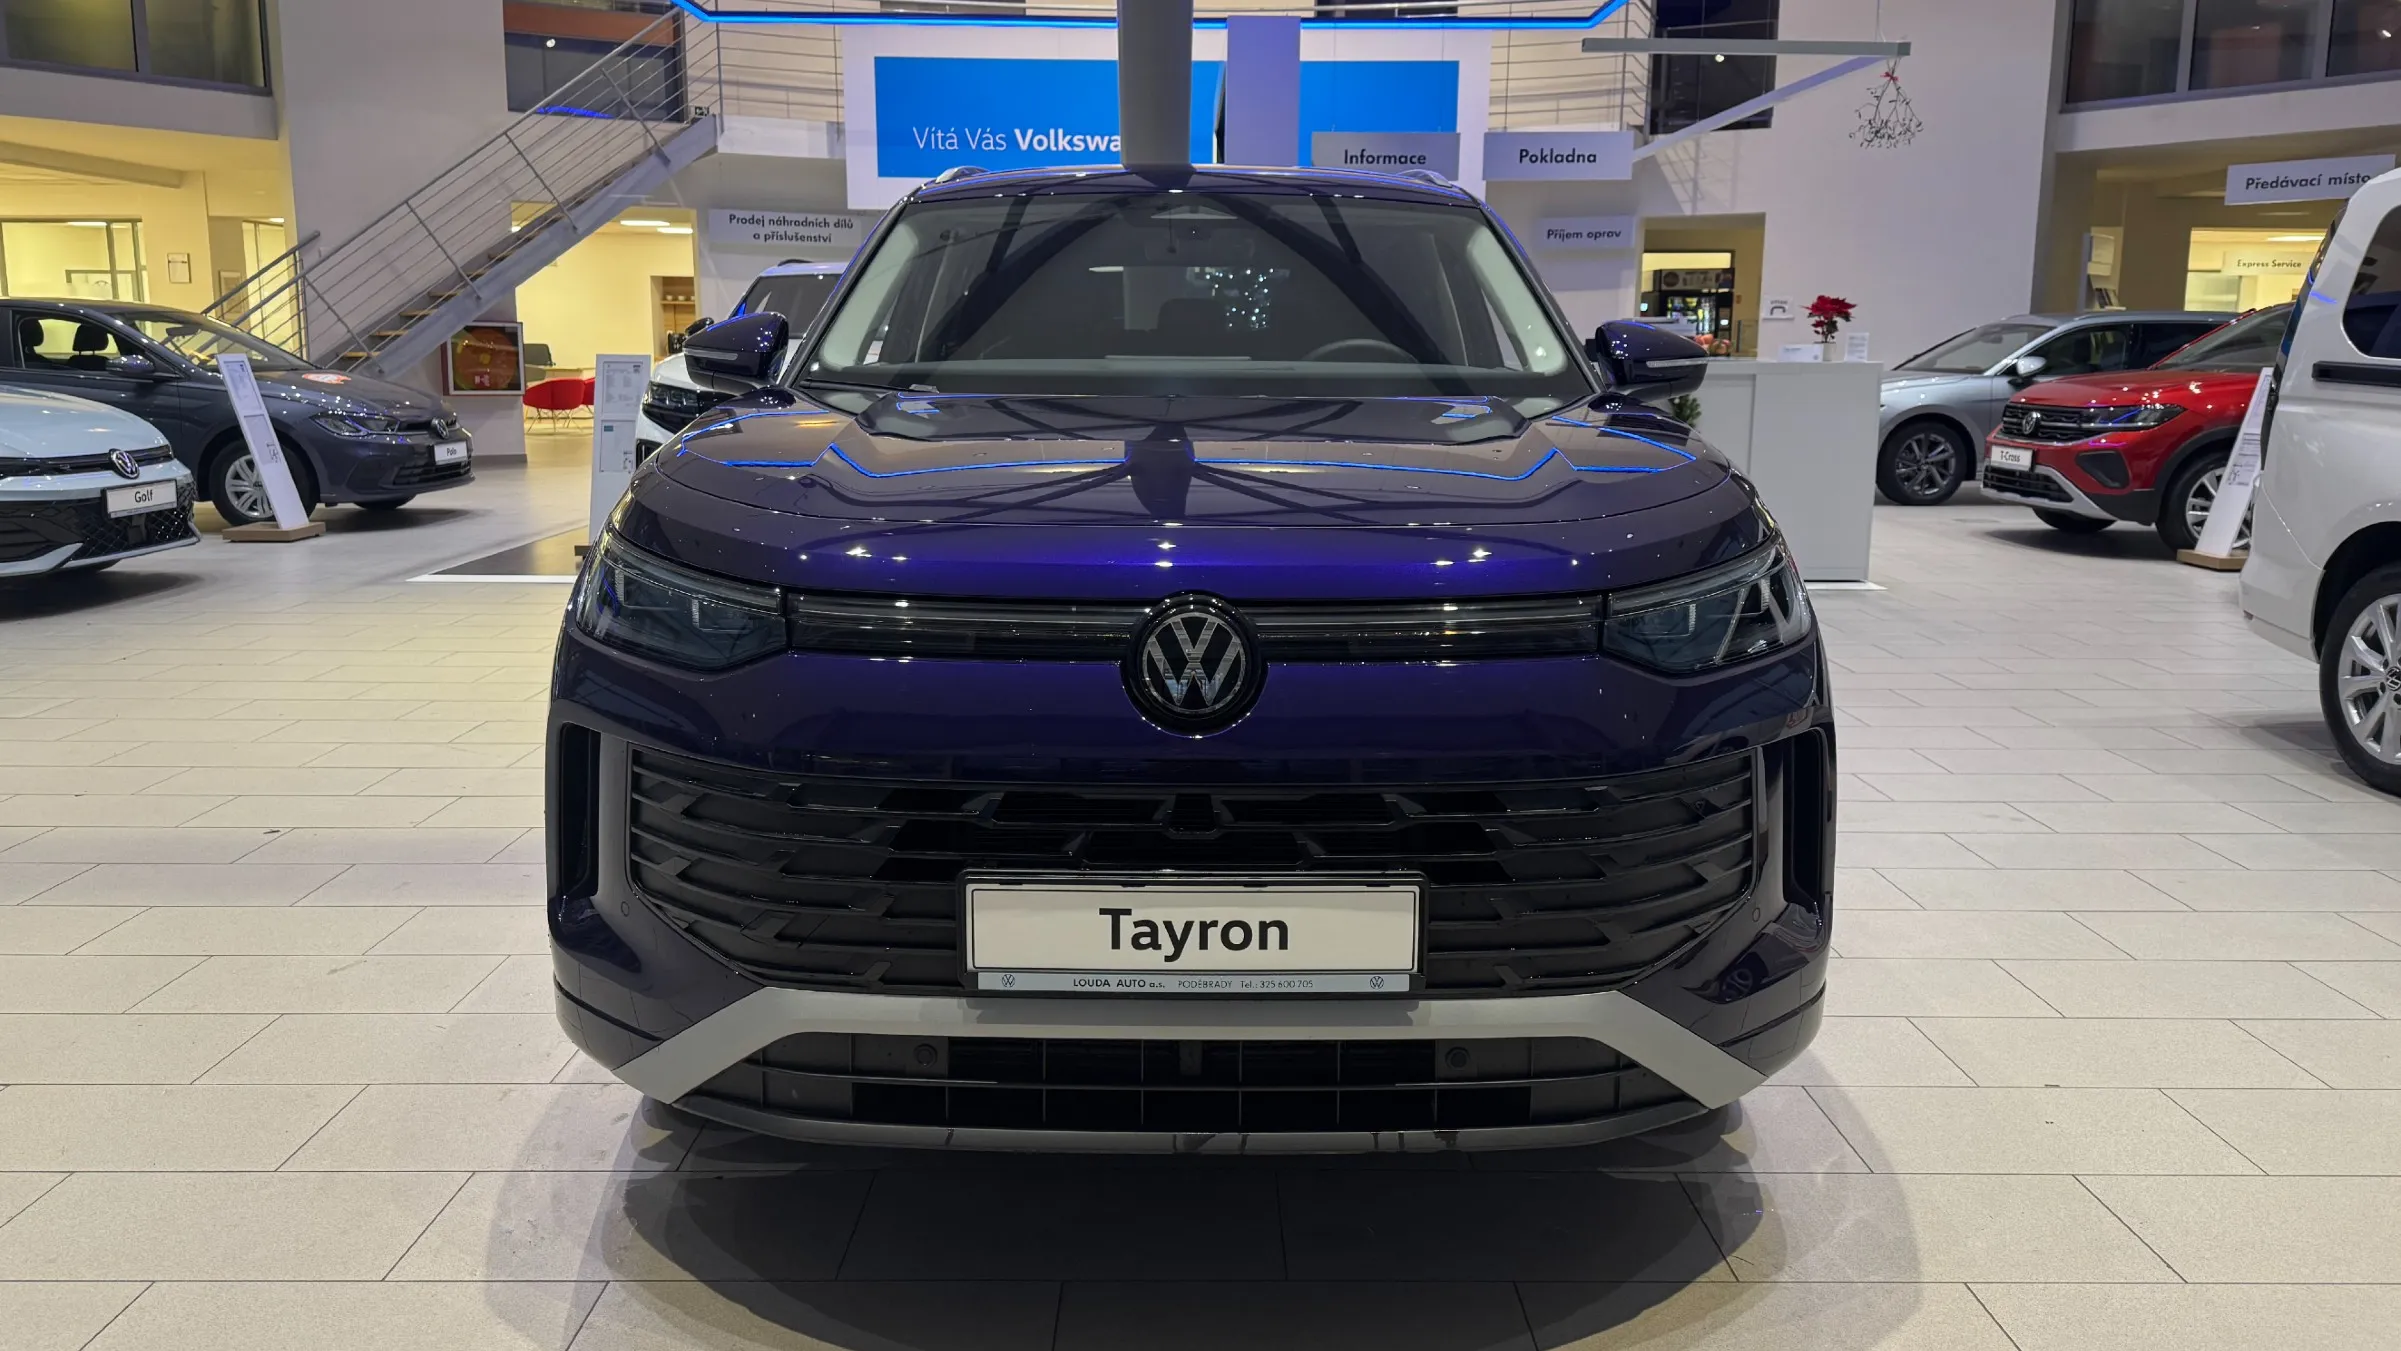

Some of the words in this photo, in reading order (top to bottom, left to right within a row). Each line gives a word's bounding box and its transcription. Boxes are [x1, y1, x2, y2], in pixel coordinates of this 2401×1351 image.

[912, 126, 959, 150] Vítá
[965, 127, 1007, 150] Vás
[1344, 149, 1427, 166] Informace
[1519, 148, 1597, 164] Pokladna
[2245, 174, 2323, 190] Předávací
[2328, 172, 2371, 186] místo
[729, 213, 765, 227] Prodej
[768, 215, 830, 229] náhradních
[833, 217, 854, 230] dílů
[753, 232, 760, 240] a
[764, 231, 832, 243] příslušenství
[1547, 228, 1583, 242] Příjem
[1586, 230, 1622, 241] oprav
[2237, 259, 2269, 268] Express
[2271, 259, 2302, 268] Service
[134, 489, 153, 503] Golf
[1099, 908, 1289, 962] Tayron
[1073, 978, 1111, 988] LOUDA
[1116, 978, 1146, 988] AUTO
